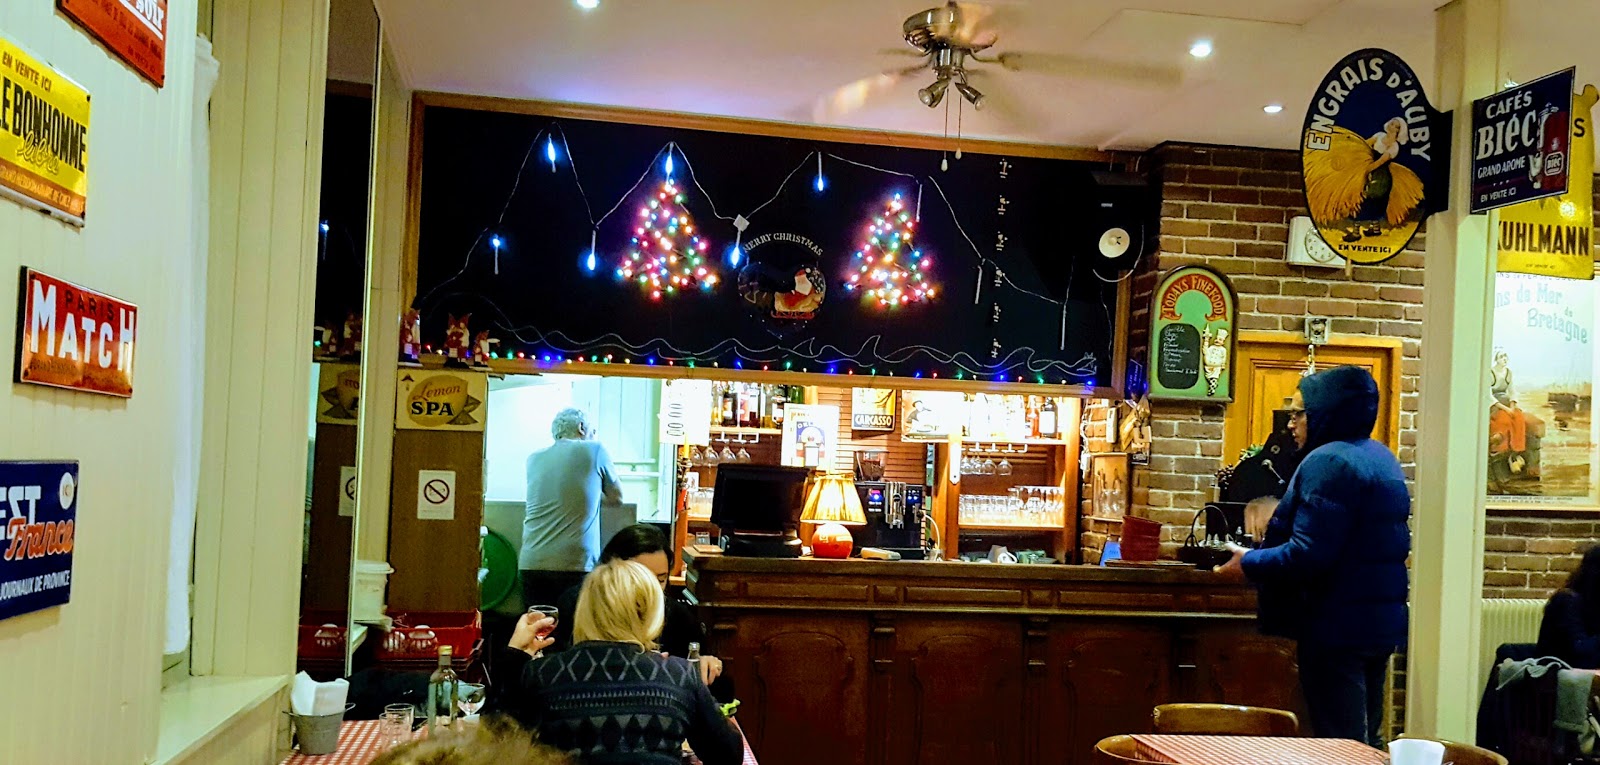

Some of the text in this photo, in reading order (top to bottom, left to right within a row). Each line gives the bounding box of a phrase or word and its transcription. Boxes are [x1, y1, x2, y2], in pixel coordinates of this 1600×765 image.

[2, 51, 52, 93] EN VENTE ICI
[1308, 57, 1432, 162] ENGRAIS D'AUBY
[1485, 91, 1533, 120] CAFÉS
[0, 76, 87, 173] E BONHOMME
[1477, 155, 1526, 180] GRAND AROME
[1480, 186, 1517, 203] EN VENTE ICI
[773, 232, 823, 257] CHRISTMAS
[1351, 244, 1378, 253] VENTE
[1380, 245, 1392, 254] ICI
[1498, 220, 1590, 257] UHLMANN
[65, 289, 115, 321] PARIS
[1161, 278, 1190, 314] TODAYS
[30, 279, 135, 373] MATCH
[1527, 307, 1588, 344] Bretagne
[412, 381, 462, 402] Lemon
[411, 401, 454, 416] SPA
[855, 414, 892, 427] CARCASSO
[4, 516, 74, 562] France
[0, 569, 71, 601] JOURNAUX DE PROVINCE
